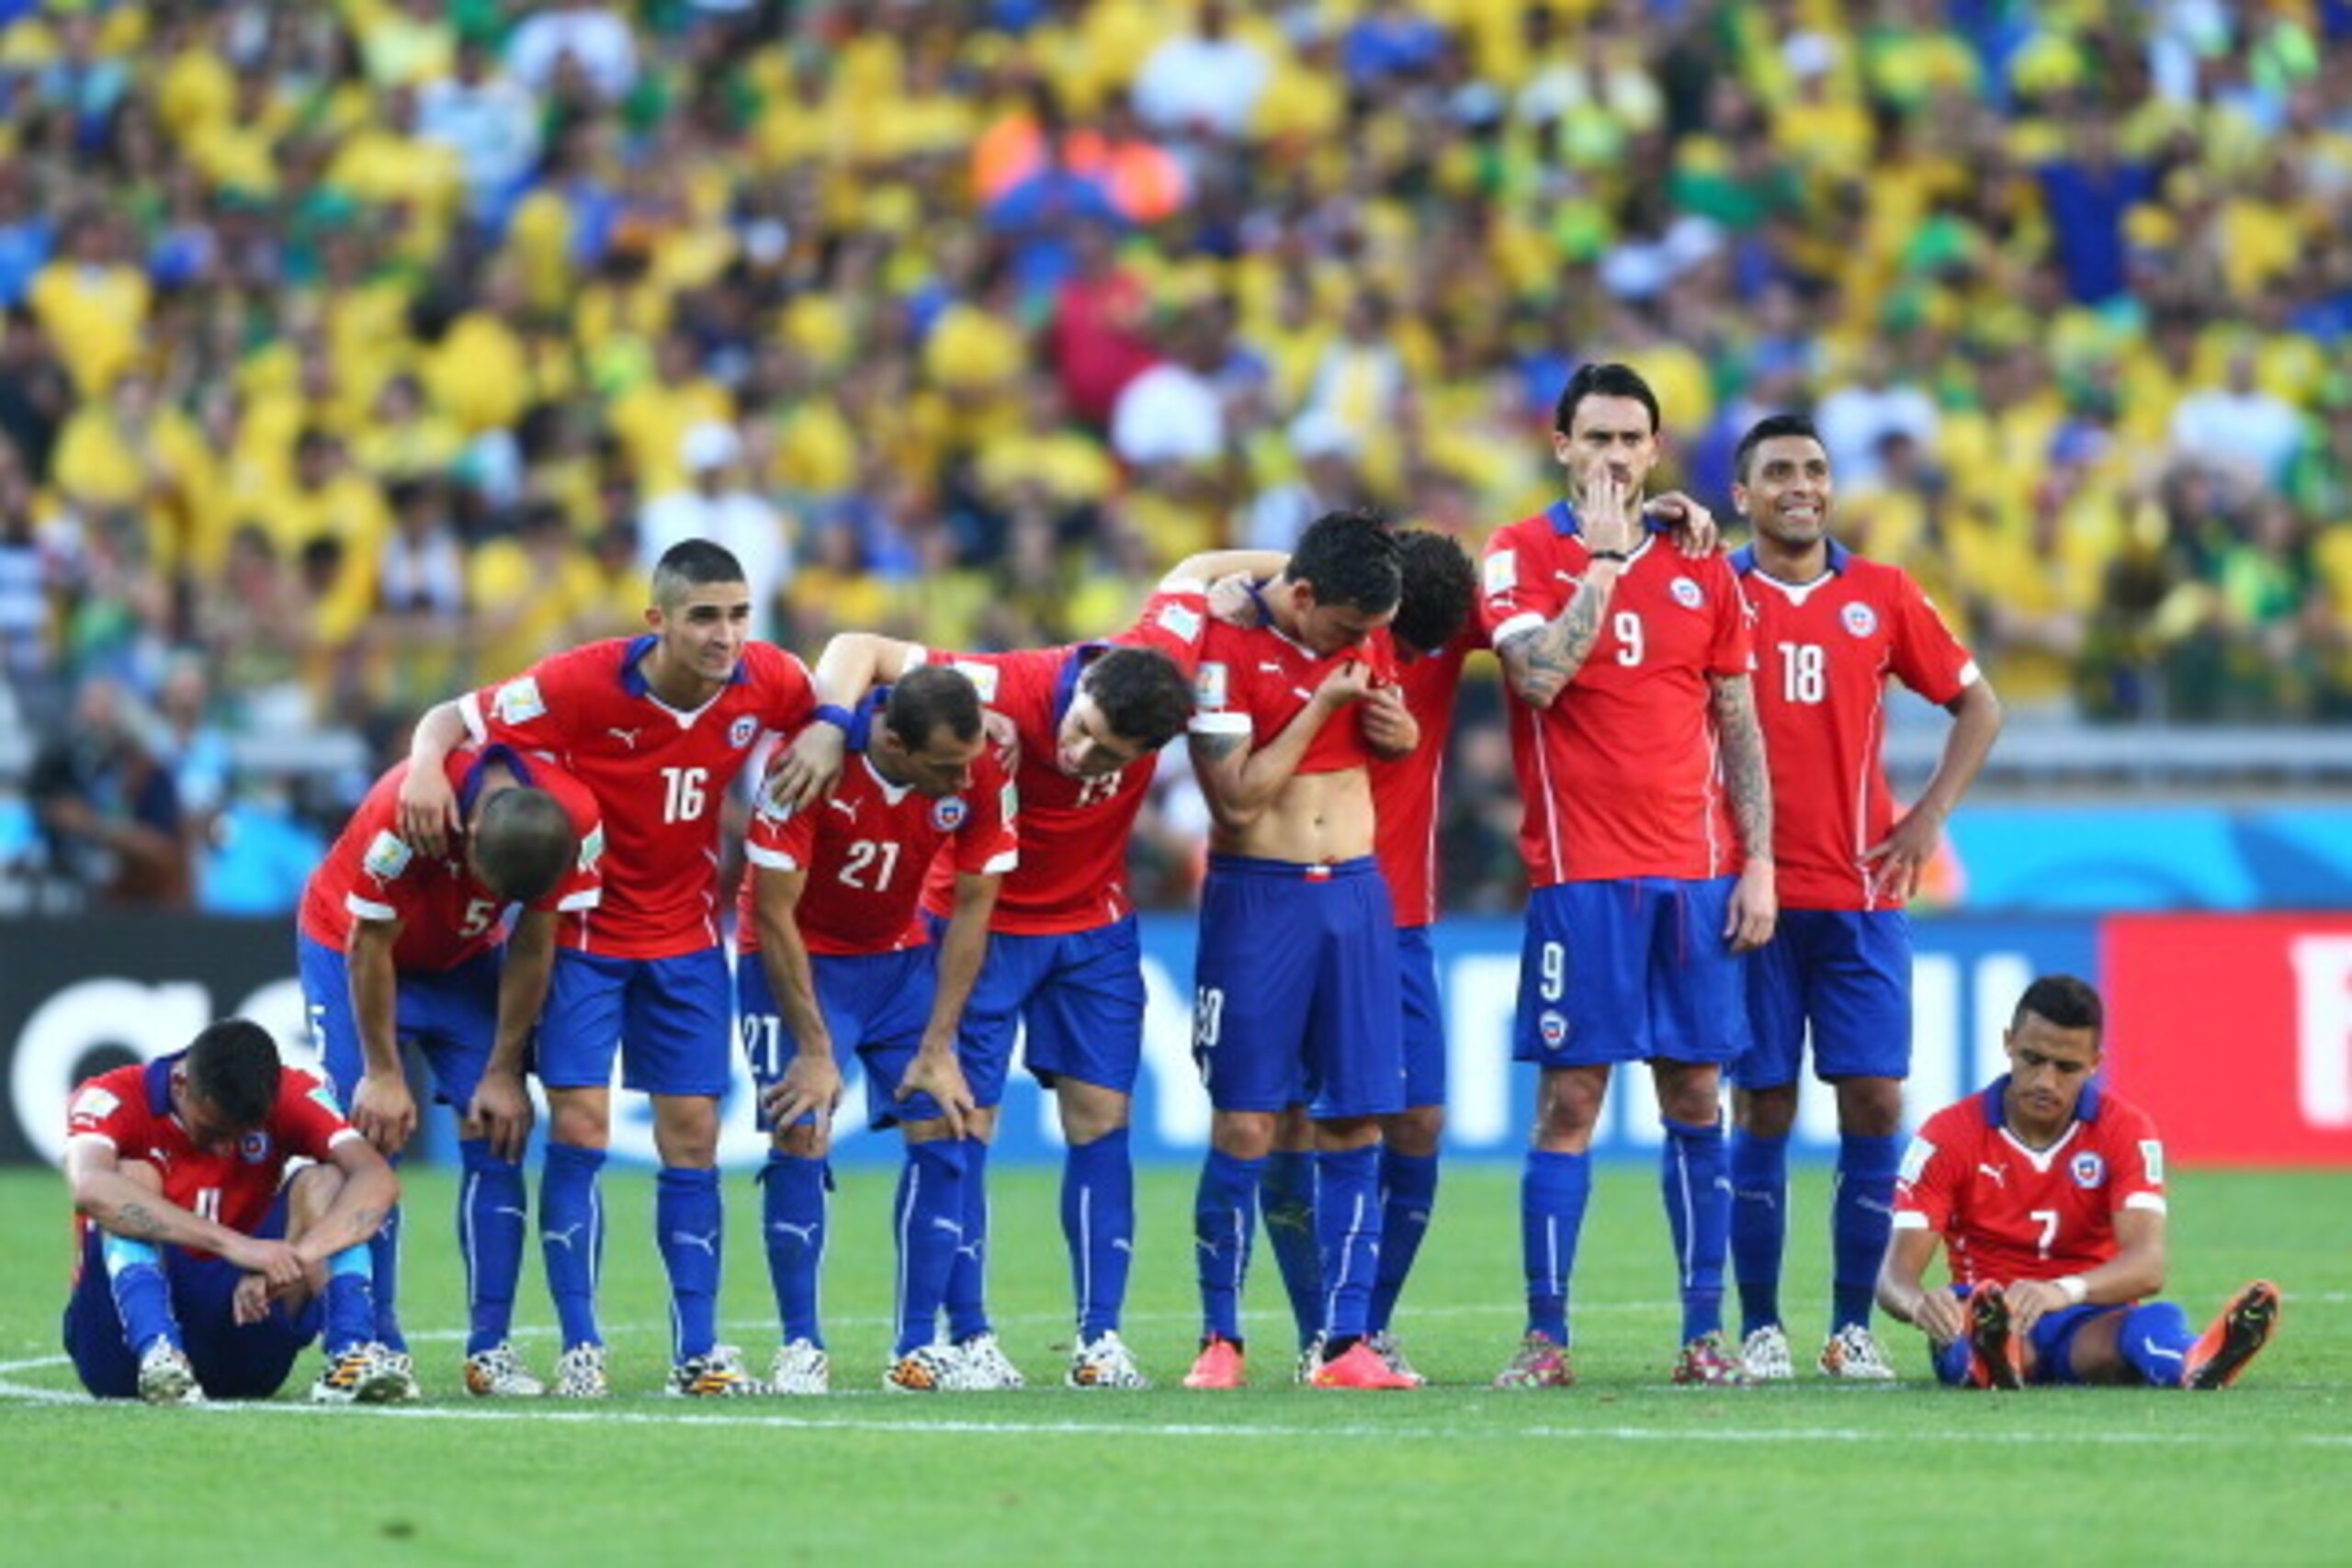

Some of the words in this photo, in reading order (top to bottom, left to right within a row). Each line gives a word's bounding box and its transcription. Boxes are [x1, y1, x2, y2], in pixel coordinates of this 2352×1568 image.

[1614, 612, 1644, 667] 9
[1777, 642, 1822, 704] 18
[661, 767, 707, 824] 16
[839, 839, 899, 892] 21
[458, 899, 495, 937] 5
[1540, 942, 1564, 1001] 9
[744, 1013, 780, 1076] 21
[2030, 1210, 2058, 1261] 7
